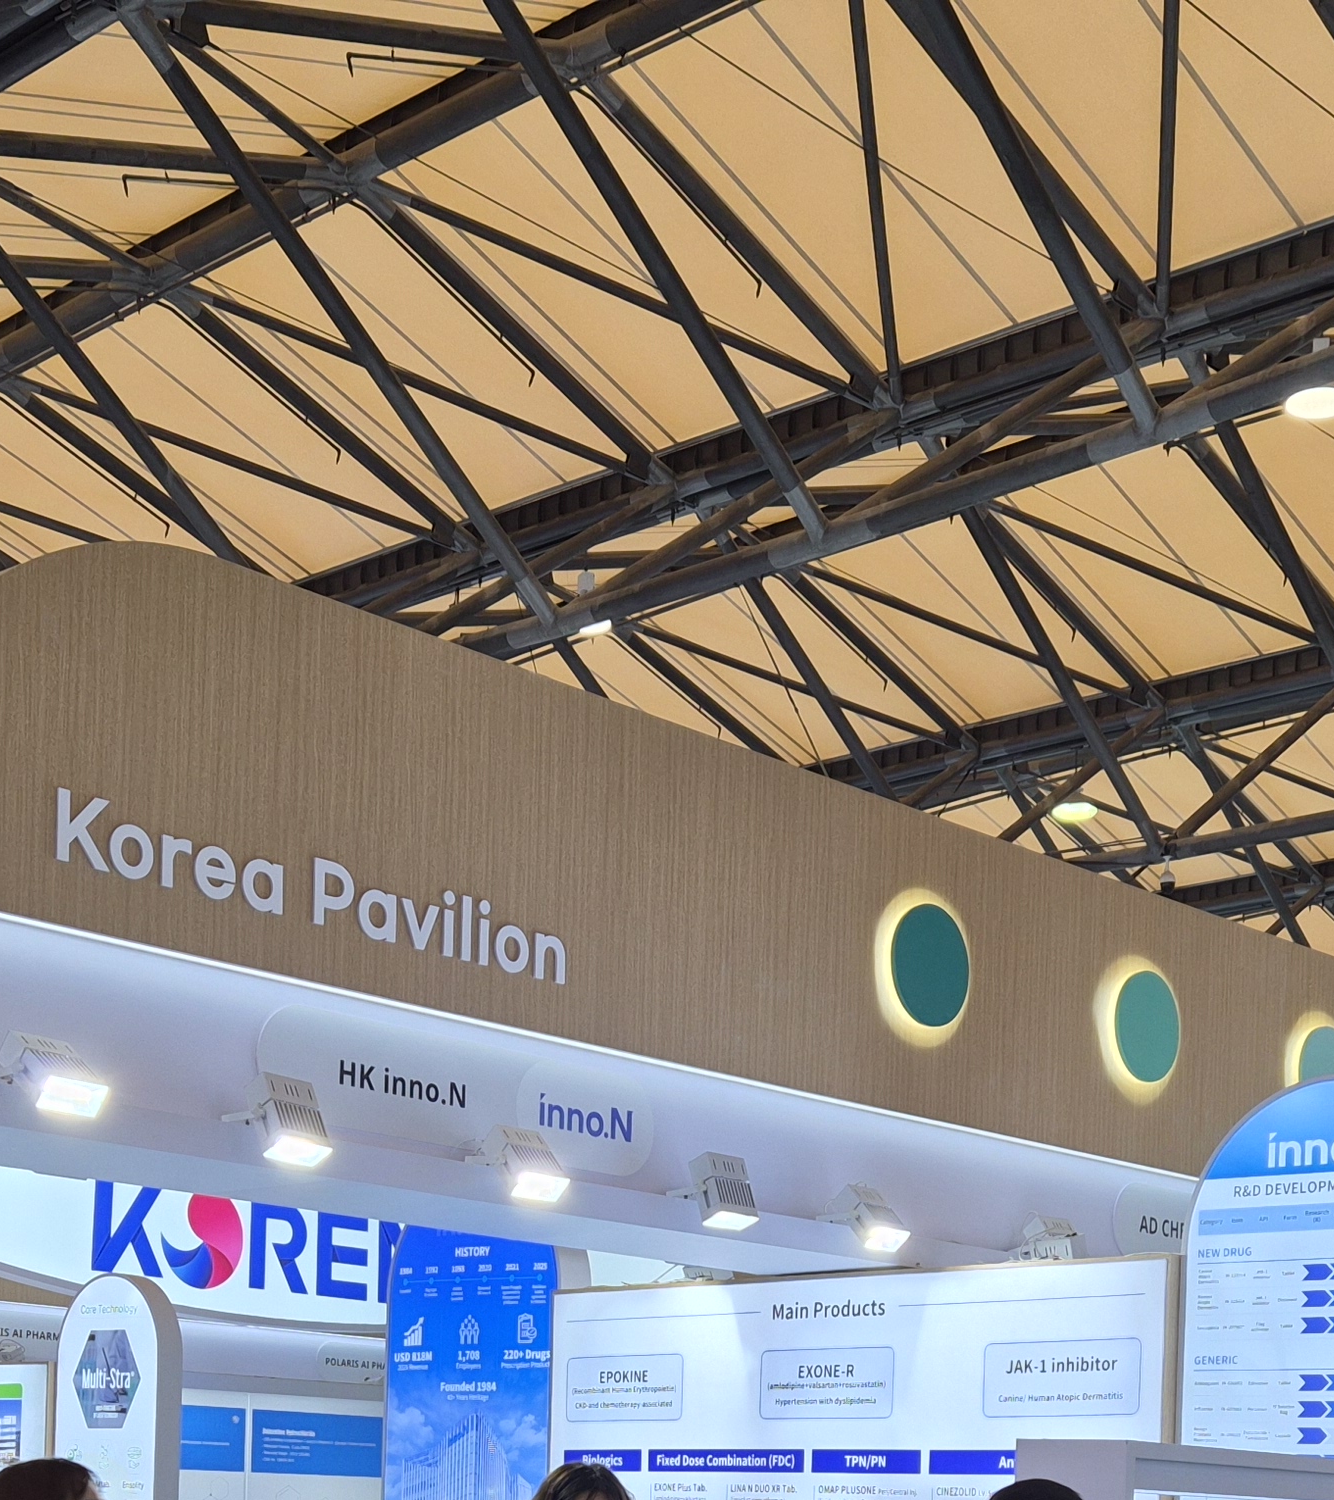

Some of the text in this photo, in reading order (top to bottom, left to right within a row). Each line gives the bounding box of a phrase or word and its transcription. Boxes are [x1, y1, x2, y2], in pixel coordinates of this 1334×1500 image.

[55, 786, 566, 985] Korea Pavilion
[339, 1059, 466, 1109] HK inno.N
[539, 1092, 634, 1143] inno.N
[1233, 1183, 1261, 1198] R&D
[1139, 1215, 1158, 1234] AD
[454, 1246, 491, 1258] HISTORY
[1198, 1247, 1253, 1258] NEW DRUG
[80, 1304, 139, 1316] Core Technology
[772, 1299, 886, 1320] Main Products
[12, 1328, 23, 1338] AI
[503, 1349, 550, 1361] 220+ Drugs
[1193, 1355, 1239, 1366] GENERIC
[325, 1357, 370, 1369] POLARIS AI
[1005, 1356, 1118, 1374] JAK-1 inhibitor
[599, 1370, 649, 1384] EPOKINE
[798, 1364, 855, 1379] EXONE-R
[440, 1381, 497, 1392] Founded 1984
[775, 1396, 877, 1407] Hypertension with dyslipidemia
[1027, 1393, 1055, 1402] Human
[1057, 1392, 1081, 1403] Atopic
[1082, 1391, 1124, 1401] Dermatitis
[656, 1453, 795, 1469] Fixed Dose Combination (FDC)
[844, 1455, 886, 1470] TPN/PN
[999, 1456, 1016, 1469] An
[654, 1483, 677, 1492] EXONE
[693, 1483, 708, 1492] Tab.
[730, 1484, 746, 1493] LINA
[747, 1484, 753, 1493] N
[754, 1484, 770, 1493] DUO
[782, 1484, 798, 1493] Tab.
[818, 1485, 840, 1494] OMAP
[841, 1486, 876, 1495] PLUSONE
[936, 1487, 977, 1497] CINEZOLID
